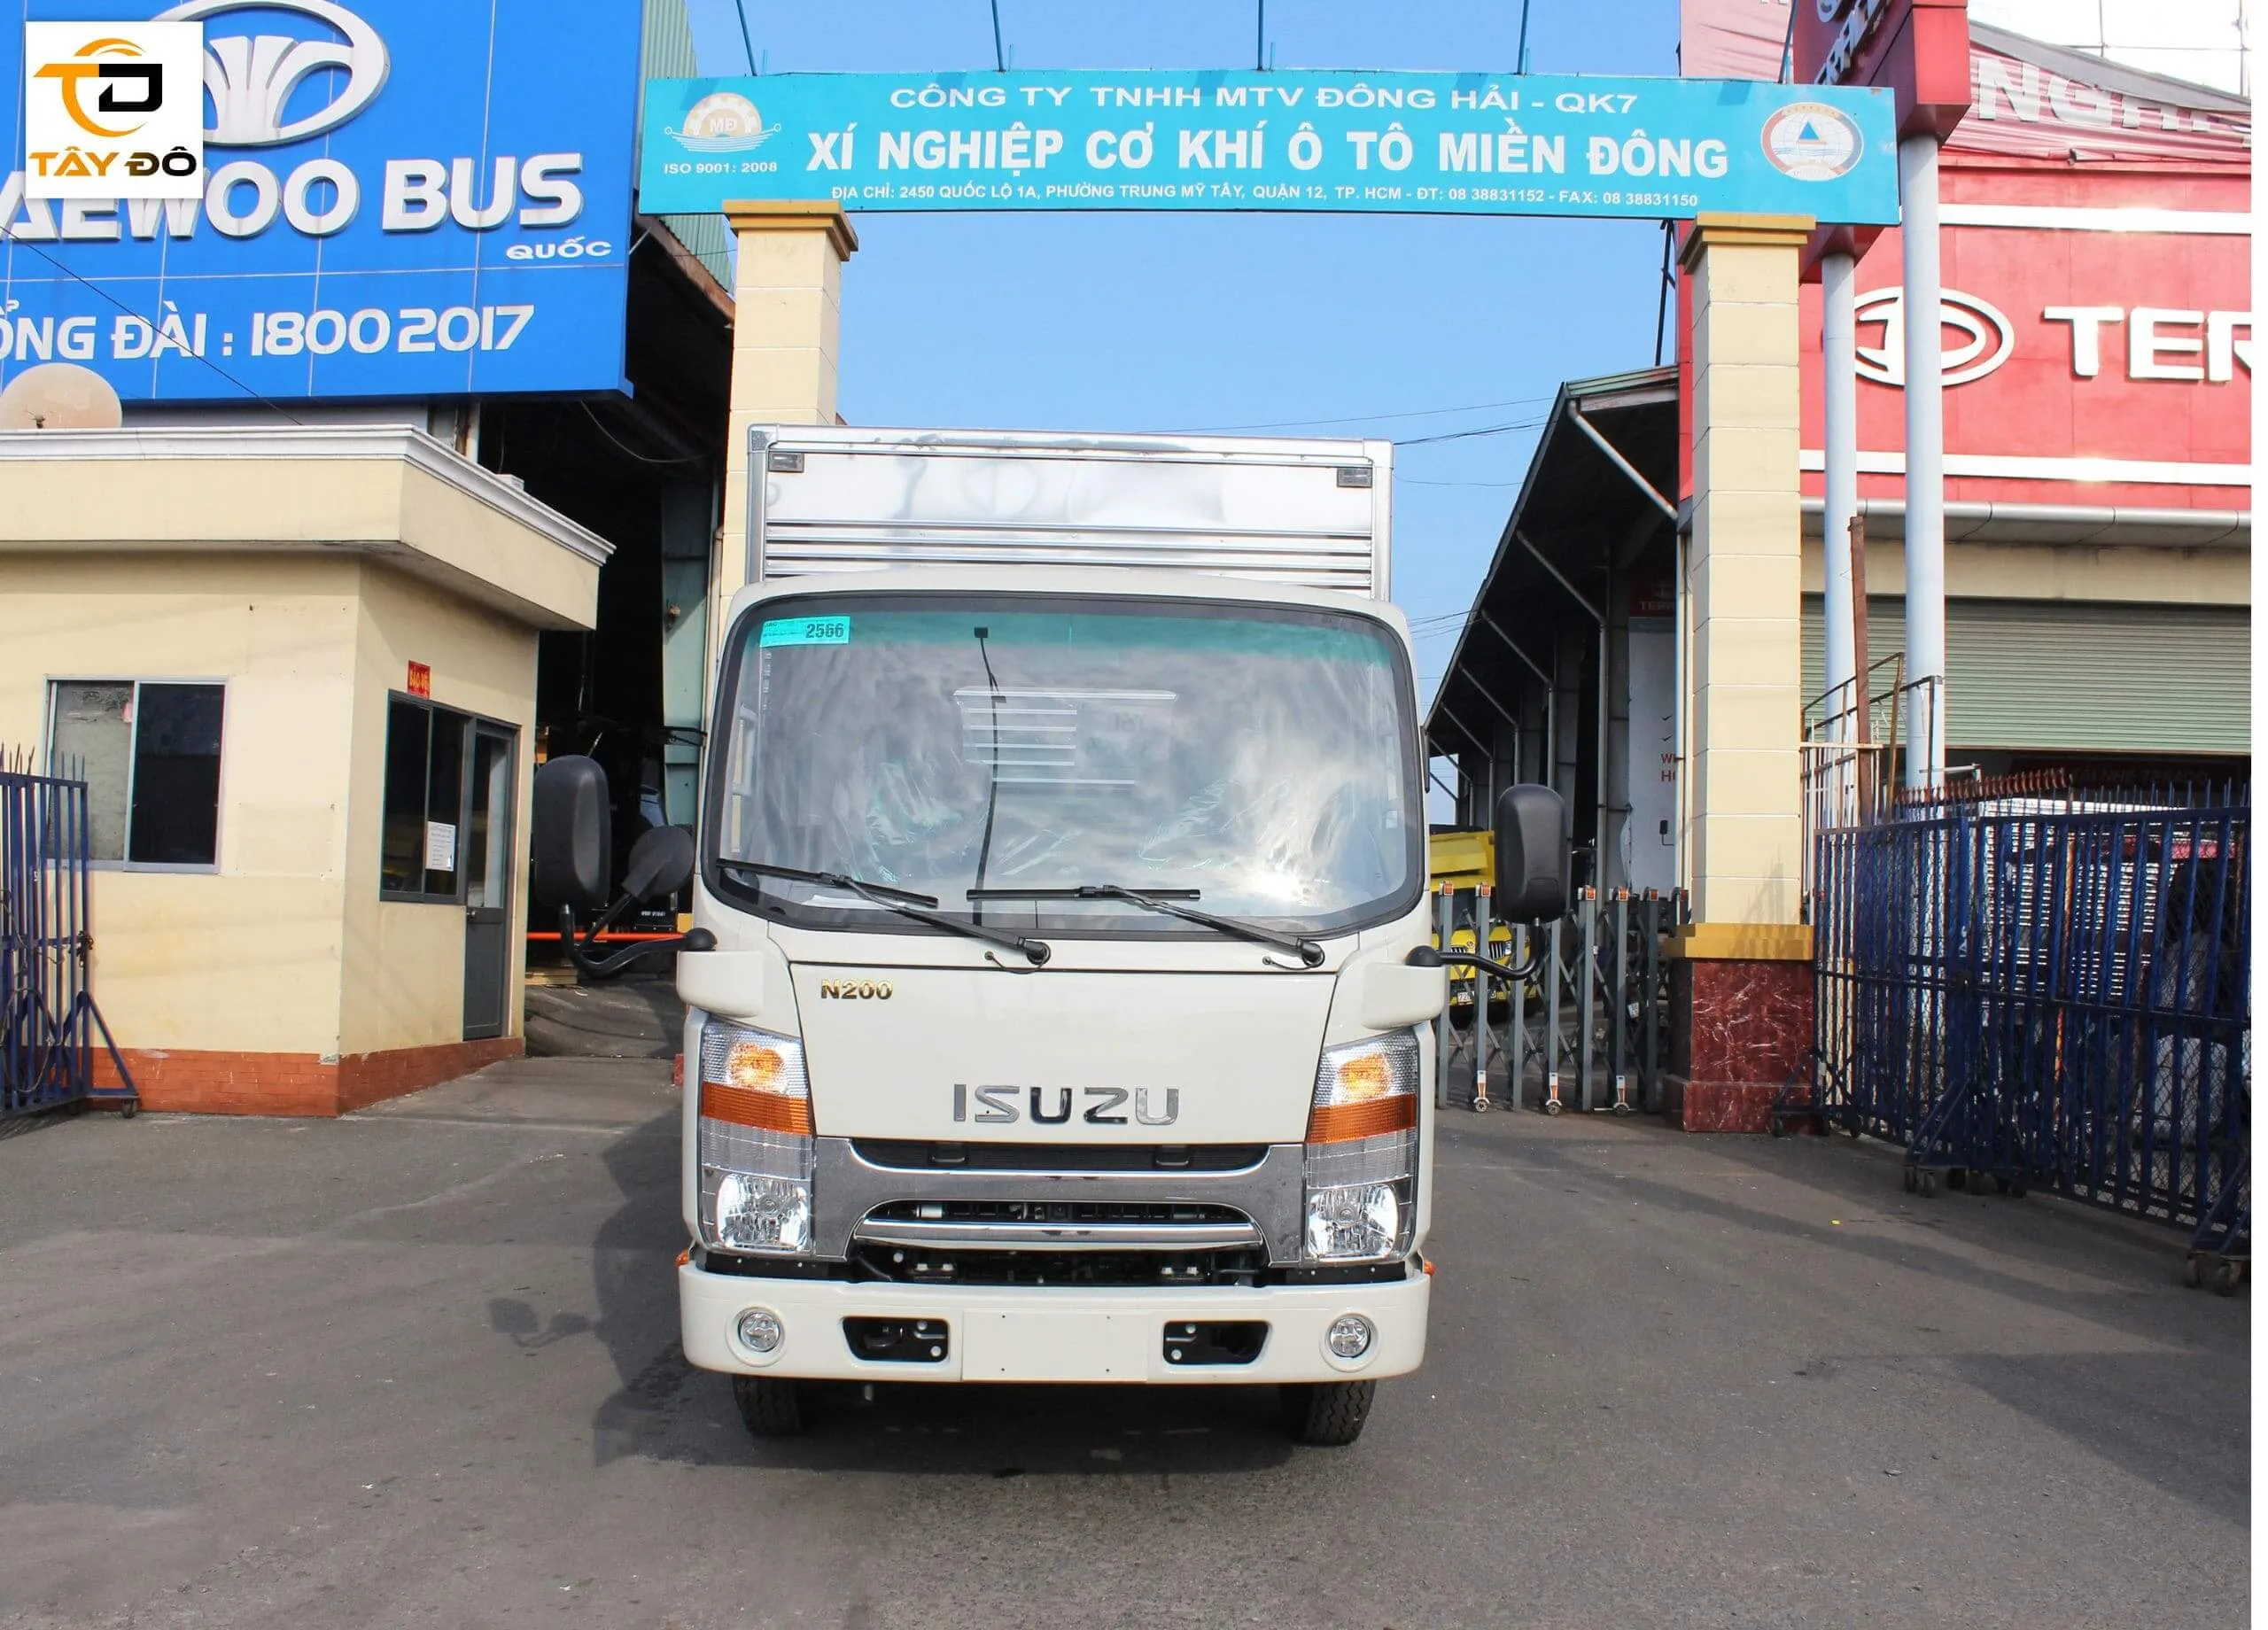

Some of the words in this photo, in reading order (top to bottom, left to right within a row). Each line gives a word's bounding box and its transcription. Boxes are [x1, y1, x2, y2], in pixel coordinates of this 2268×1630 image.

[889, 83, 1006, 108] CÔNG
[1020, 87, 1073, 107] TY
[1090, 87, 1200, 107] TNHH
[1216, 87, 1304, 107] MTV
[1315, 82, 1436, 109] ĐÔNG
[1451, 85, 1518, 111] HẢI
[1555, 92, 1637, 113] QK7
[805, 122, 858, 171] XÍ
[878, 121, 1063, 176] NGHIỆP
[1085, 121, 1153, 169] CƠ
[1178, 120, 1268, 168] KHÍ
[1287, 121, 1323, 170] Ô
[1346, 122, 1413, 171] TÔ
[1439, 117, 1565, 174] MIỀN
[1586, 128, 1728, 178] ĐÔNG
[664, 163, 691, 174] ISO
[695, 162, 737, 174] 9001:
[741, 162, 777, 173] 2008
[383, 152, 585, 234] BUS
[831, 185, 858, 200] ĐỊA
[863, 182, 895, 198] CHỈ:
[899, 186, 935, 198] 2450
[939, 180, 986, 199] QUỐC
[991, 182, 1013, 200] LỘ
[1017, 185, 1041, 200] 1A,
[1045, 181, 1115, 198] PHƯỜNG
[1120, 184, 1177, 198] TRUNG
[1181, 182, 1206, 198] MỸ
[1210, 182, 1246, 199] TÂY,
[1253, 183, 1300, 201] QUẬN
[1305, 186, 1327, 200] 12,
[1334, 186, 1359, 199] TP.
[1364, 187, 1402, 199] HCM
[1417, 187, 1443, 200] ĐT:
[1448, 188, 1467, 200] 08
[1471, 188, 1544, 202] 38831152
[1558, 190, 1597, 204] FAX:
[1603, 191, 1621, 205] 08
[1626, 192, 1698, 206] 38831150
[506, 237, 612, 260] QUỐC
[111, 300, 207, 360] ĐÀI
[805, 623, 845, 639] 2566
[820, 978, 894, 1001] N200
[953, 1083, 1180, 1126] ISUZU
